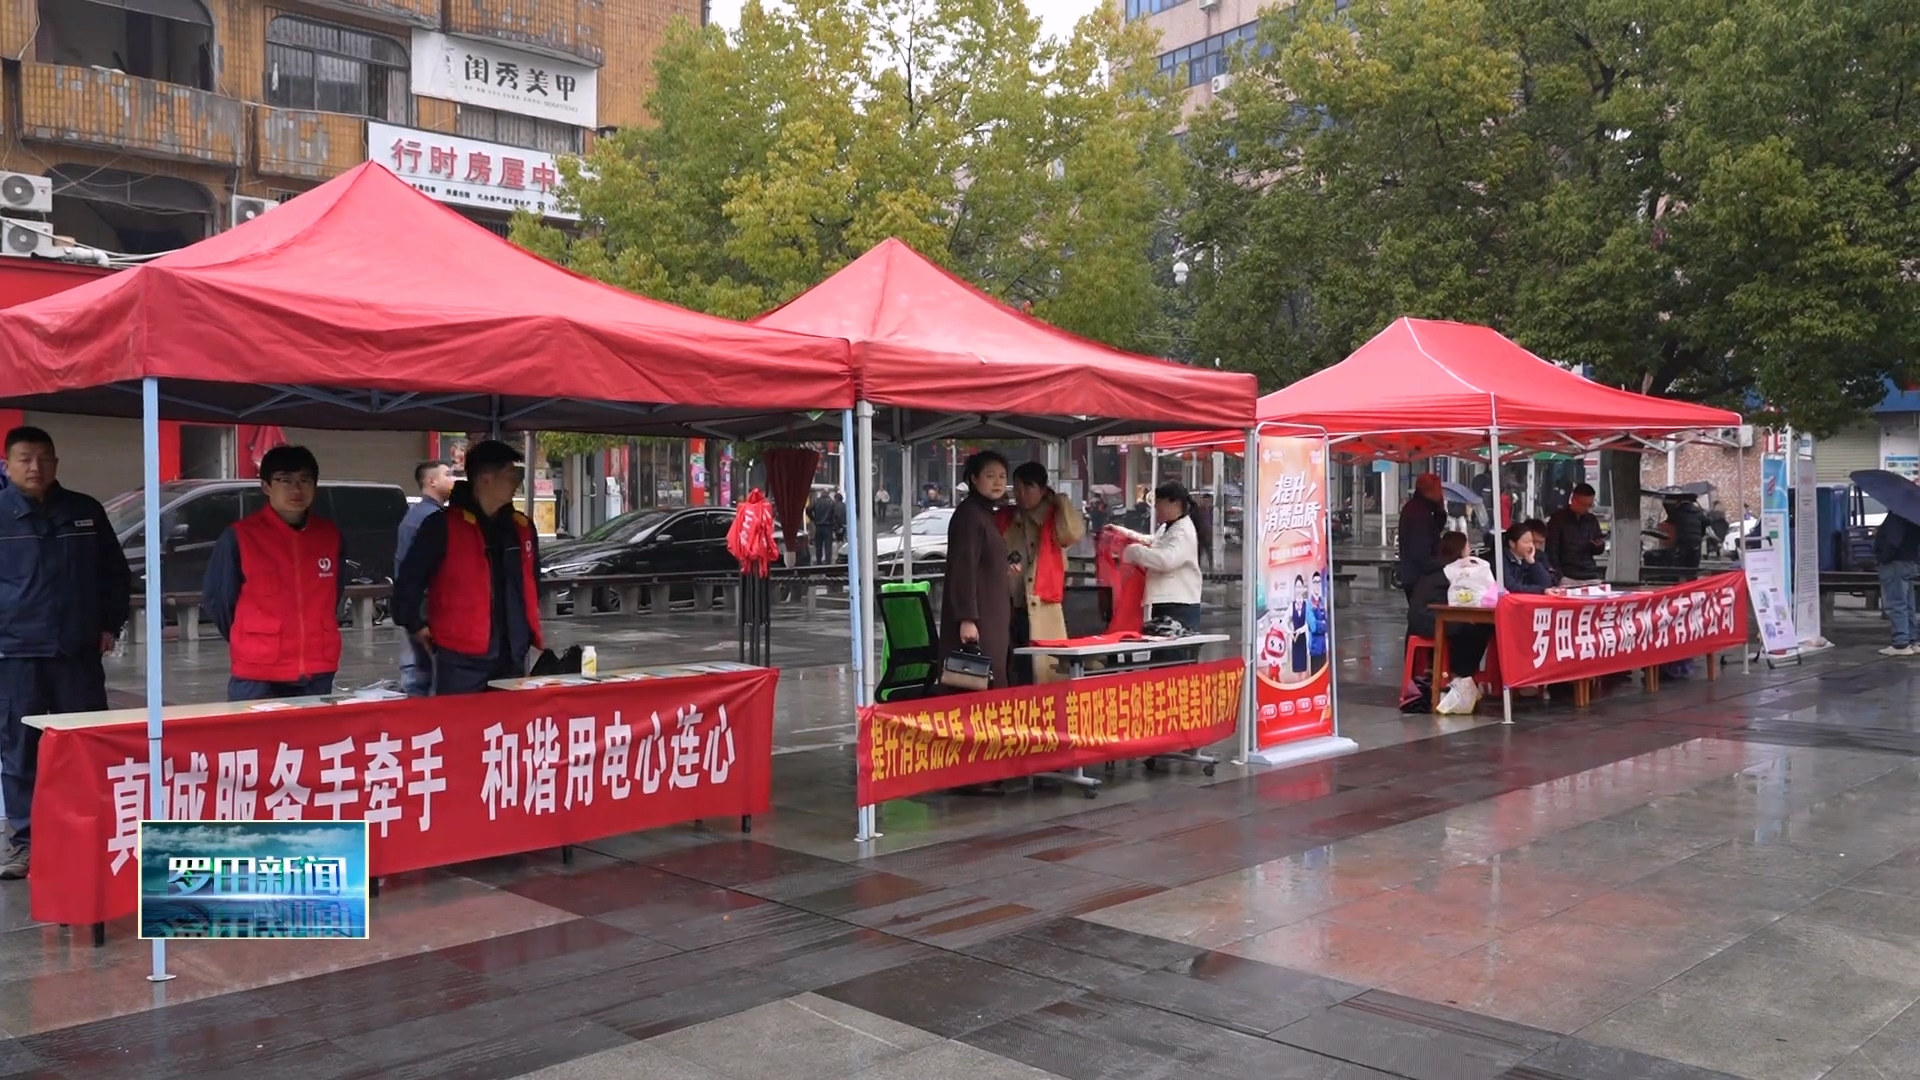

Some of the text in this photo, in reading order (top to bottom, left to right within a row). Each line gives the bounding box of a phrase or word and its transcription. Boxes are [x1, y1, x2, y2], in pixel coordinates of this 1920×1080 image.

[464, 53, 577, 102] 闺秀美甲
[391, 138, 556, 194] 行时房屋中
[1271, 471, 1306, 506] 提升
[1266, 502, 1321, 533] 消费品质
[1533, 587, 1736, 669] 罗田县清源水务有限公司
[968, 696, 1060, 763] 护航美好生活
[107, 703, 736, 876] 真诚服务手牵手 和谐用电心连心
